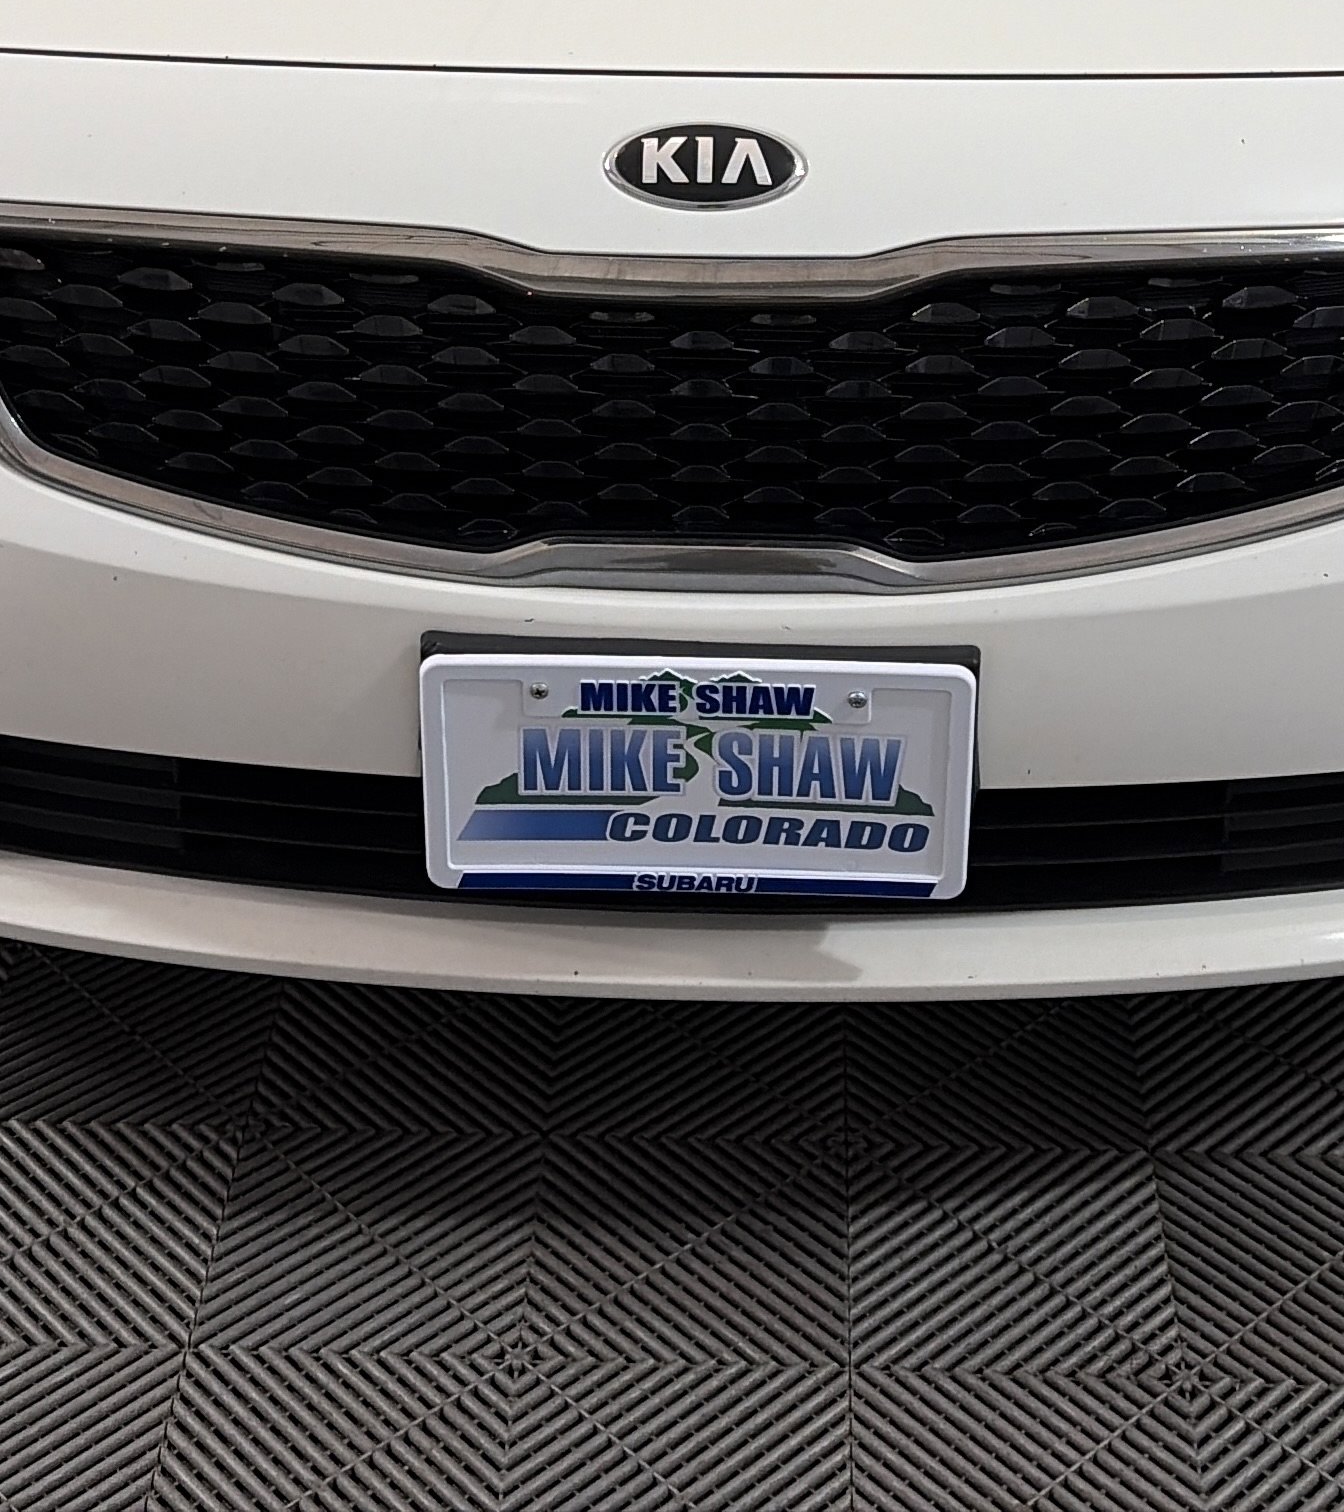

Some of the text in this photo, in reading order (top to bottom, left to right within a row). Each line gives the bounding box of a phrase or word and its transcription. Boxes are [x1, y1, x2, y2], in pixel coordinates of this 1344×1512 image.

[641, 136, 773, 186] KIA
[580, 681, 815, 716] MIKE SHAW
[522, 727, 904, 802] MIKE SHAW
[609, 811, 930, 853] COLORADO
[635, 873, 757, 893] SUBARU
